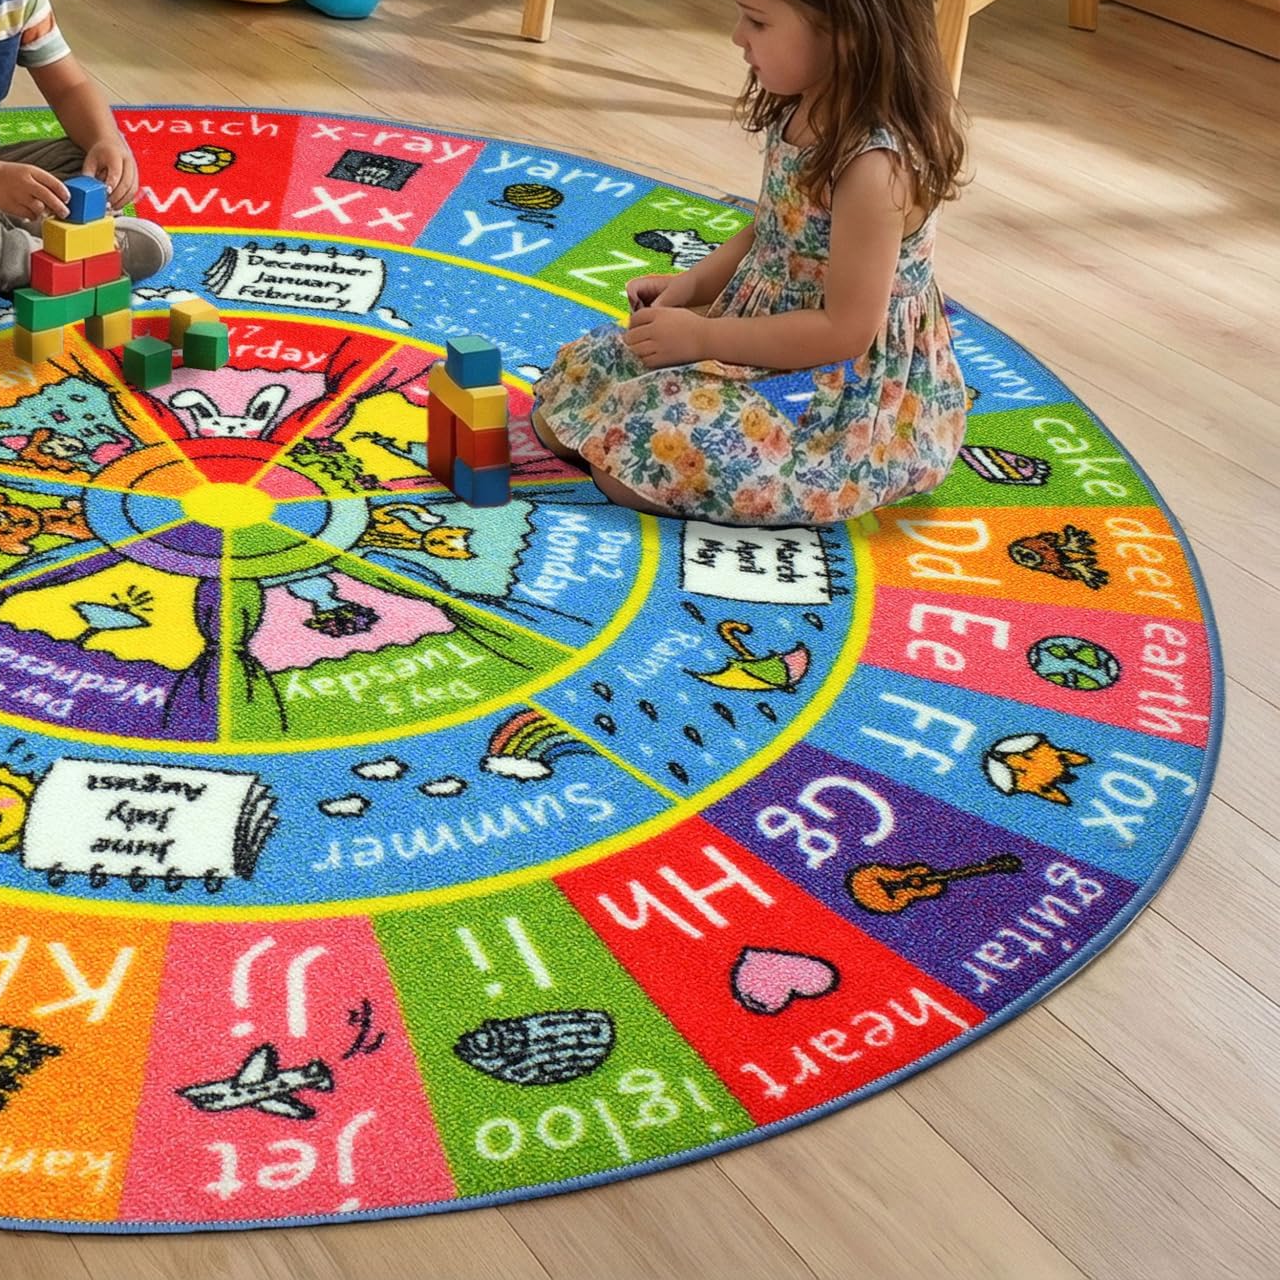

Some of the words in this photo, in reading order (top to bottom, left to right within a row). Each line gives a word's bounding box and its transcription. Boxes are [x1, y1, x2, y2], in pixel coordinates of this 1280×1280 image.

[122, 115, 280, 138] watch
[311, 123, 473, 164] x-ray
[133, 186, 272, 216] Ww
[483, 151, 637, 198] yarn
[291, 185, 418, 232] Xx
[458, 209, 553, 261] Yy
[648, 195, 740, 231] zeb
[245, 254, 373, 279] December
[253, 271, 351, 294] January
[237, 285, 352, 310] February
[951, 318, 1045, 400] unny
[1033, 417, 1128, 498] cake
[521, 510, 590, 605] Monday
[583, 529, 632, 563] Day
[688, 537, 725, 569] May
[727, 539, 766, 575] April
[775, 537, 808, 583] March
[896, 517, 1002, 587] Dd
[1105, 516, 1185, 610] deer
[906, 602, 1011, 673] Ee
[285, 640, 485, 704] Tuesday
[409, 680, 482, 708] Day
[1136, 621, 1210, 735] earth
[9, 687, 74, 719] Day
[860, 692, 978, 775] Ff
[86, 773, 208, 803] August
[104, 801, 175, 832] July
[1081, 750, 1198, 845] fox
[90, 837, 175, 862] June
[313, 782, 617, 872] Summer
[754, 774, 899, 872] Gg
[597, 843, 778, 941] Hh
[455, 916, 553, 998] Ii
[959, 860, 1106, 996] guitar
[230, 936, 329, 1039] Jj
[740, 985, 970, 1102] heart
[475, 1067, 724, 1161] igloo
[206, 1110, 378, 1213] jet
